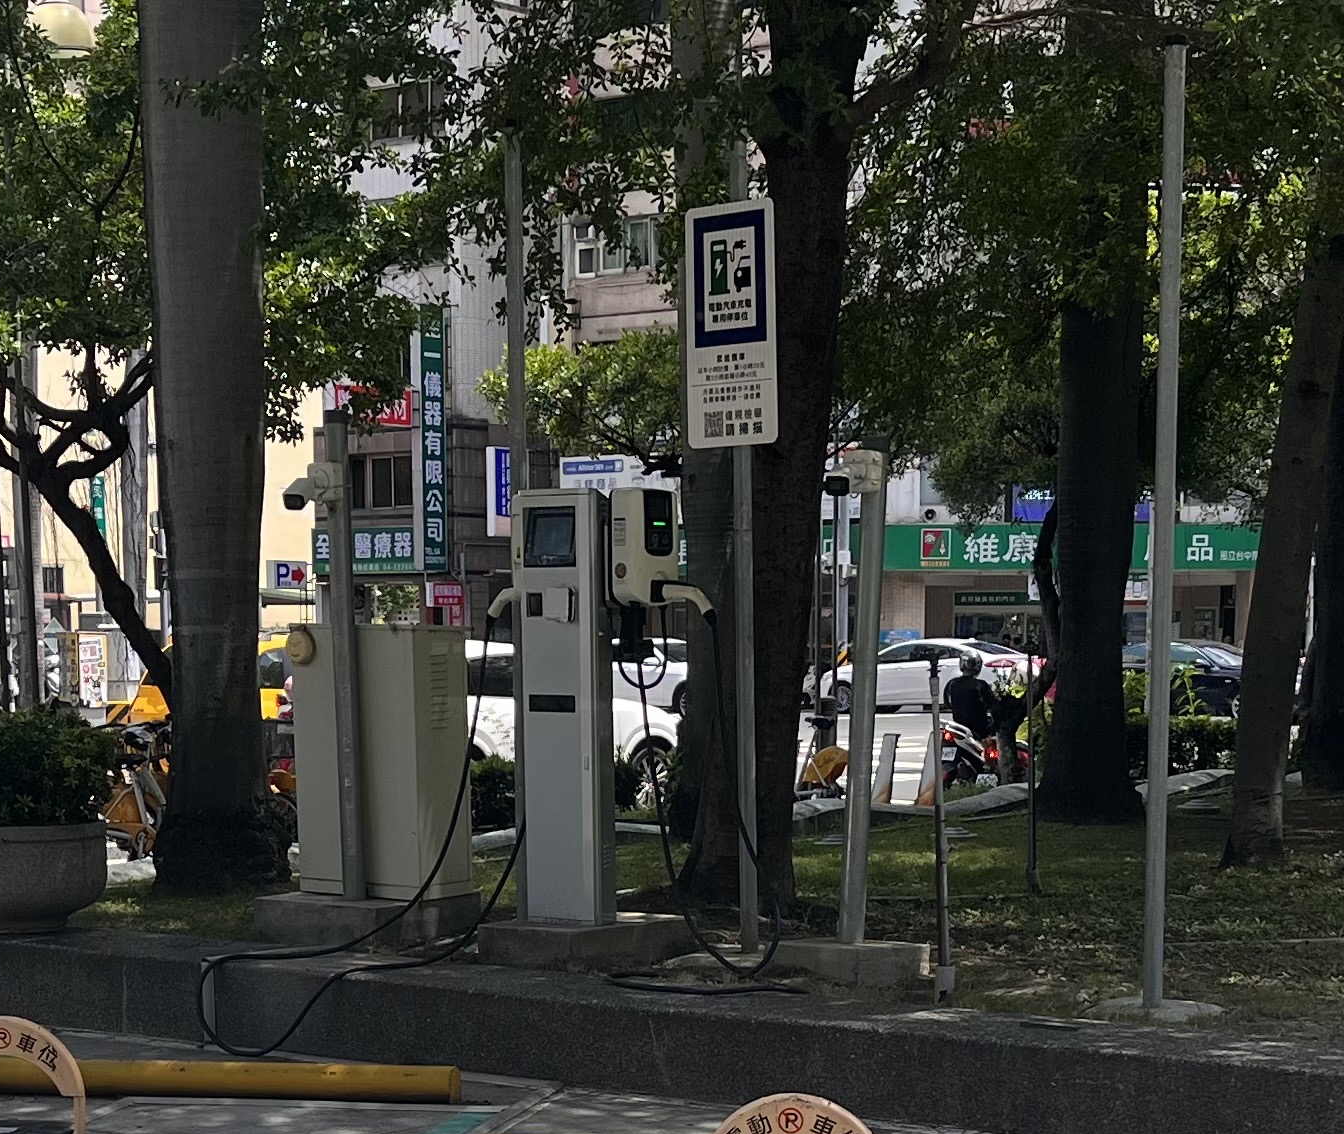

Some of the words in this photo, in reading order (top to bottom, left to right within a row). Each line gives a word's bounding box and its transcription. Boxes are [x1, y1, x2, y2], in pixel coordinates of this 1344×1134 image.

[422, 318, 445, 543] 一儀器有限公司
[276, 563, 290, 587] P
